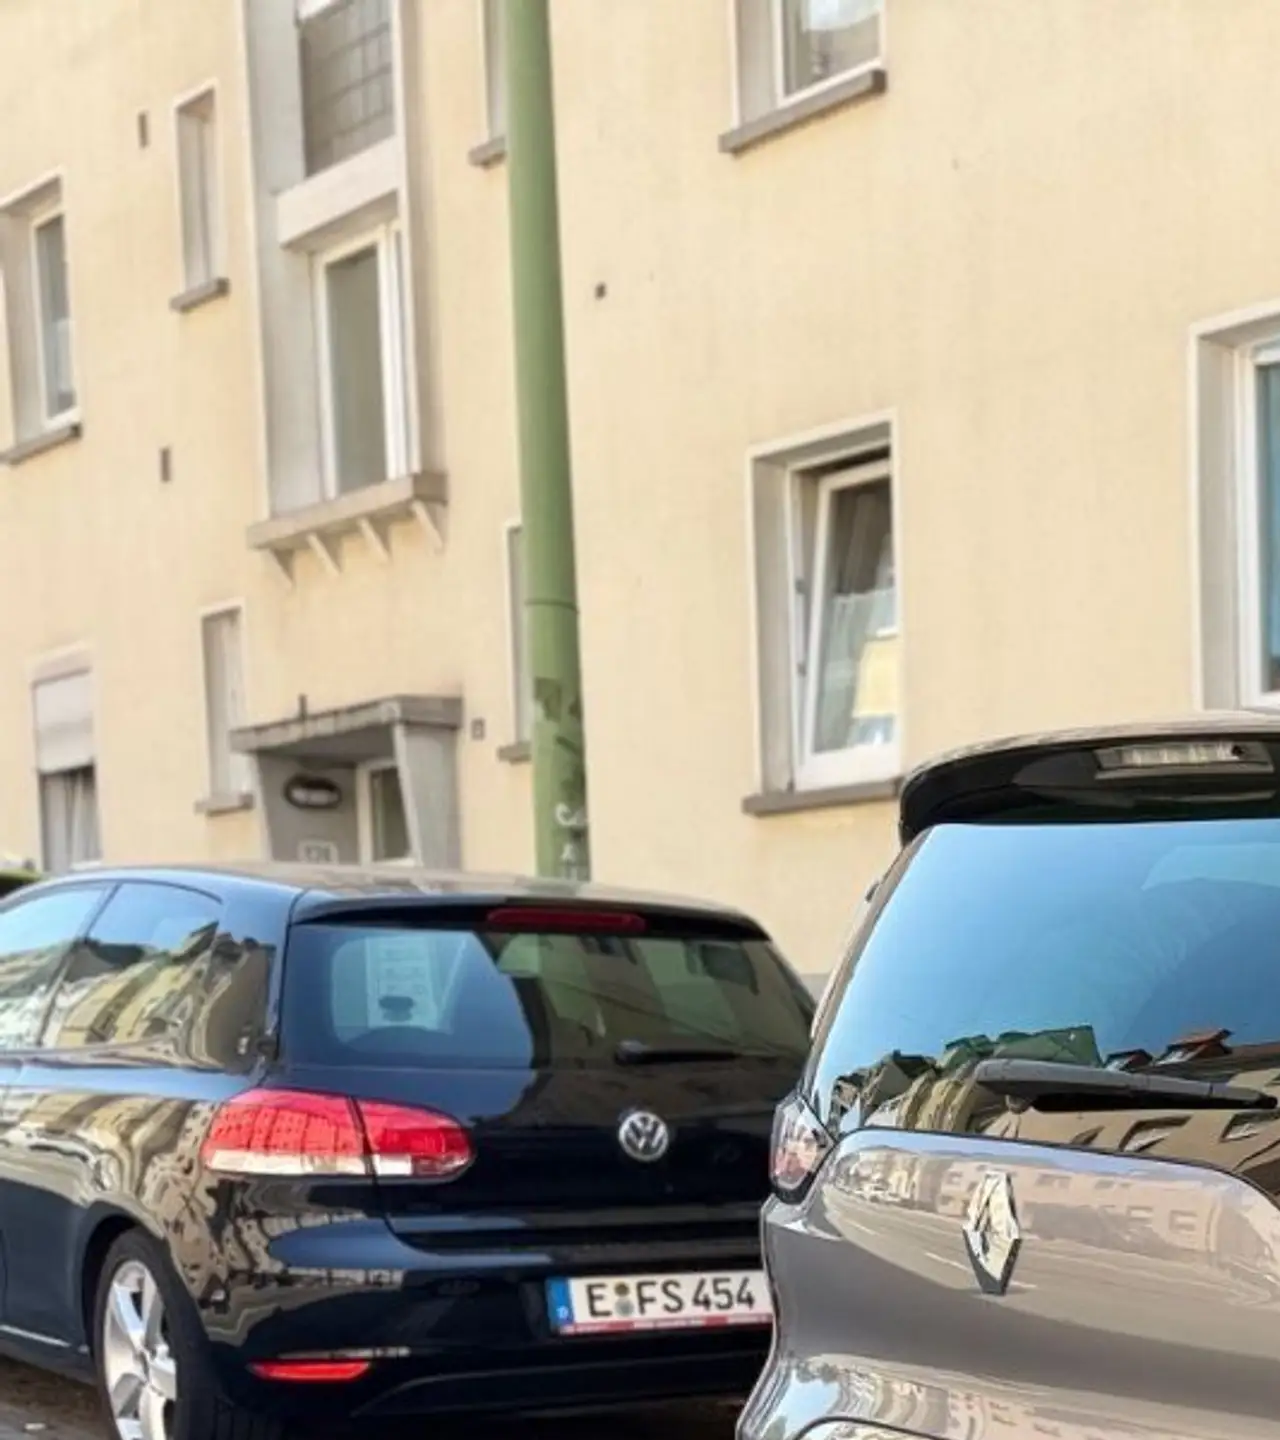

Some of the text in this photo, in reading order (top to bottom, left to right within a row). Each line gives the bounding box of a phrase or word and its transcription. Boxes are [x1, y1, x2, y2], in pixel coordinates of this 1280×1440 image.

[585, 1283, 612, 1318] E
[636, 1279, 685, 1316] FS
[692, 1276, 756, 1311] 454
